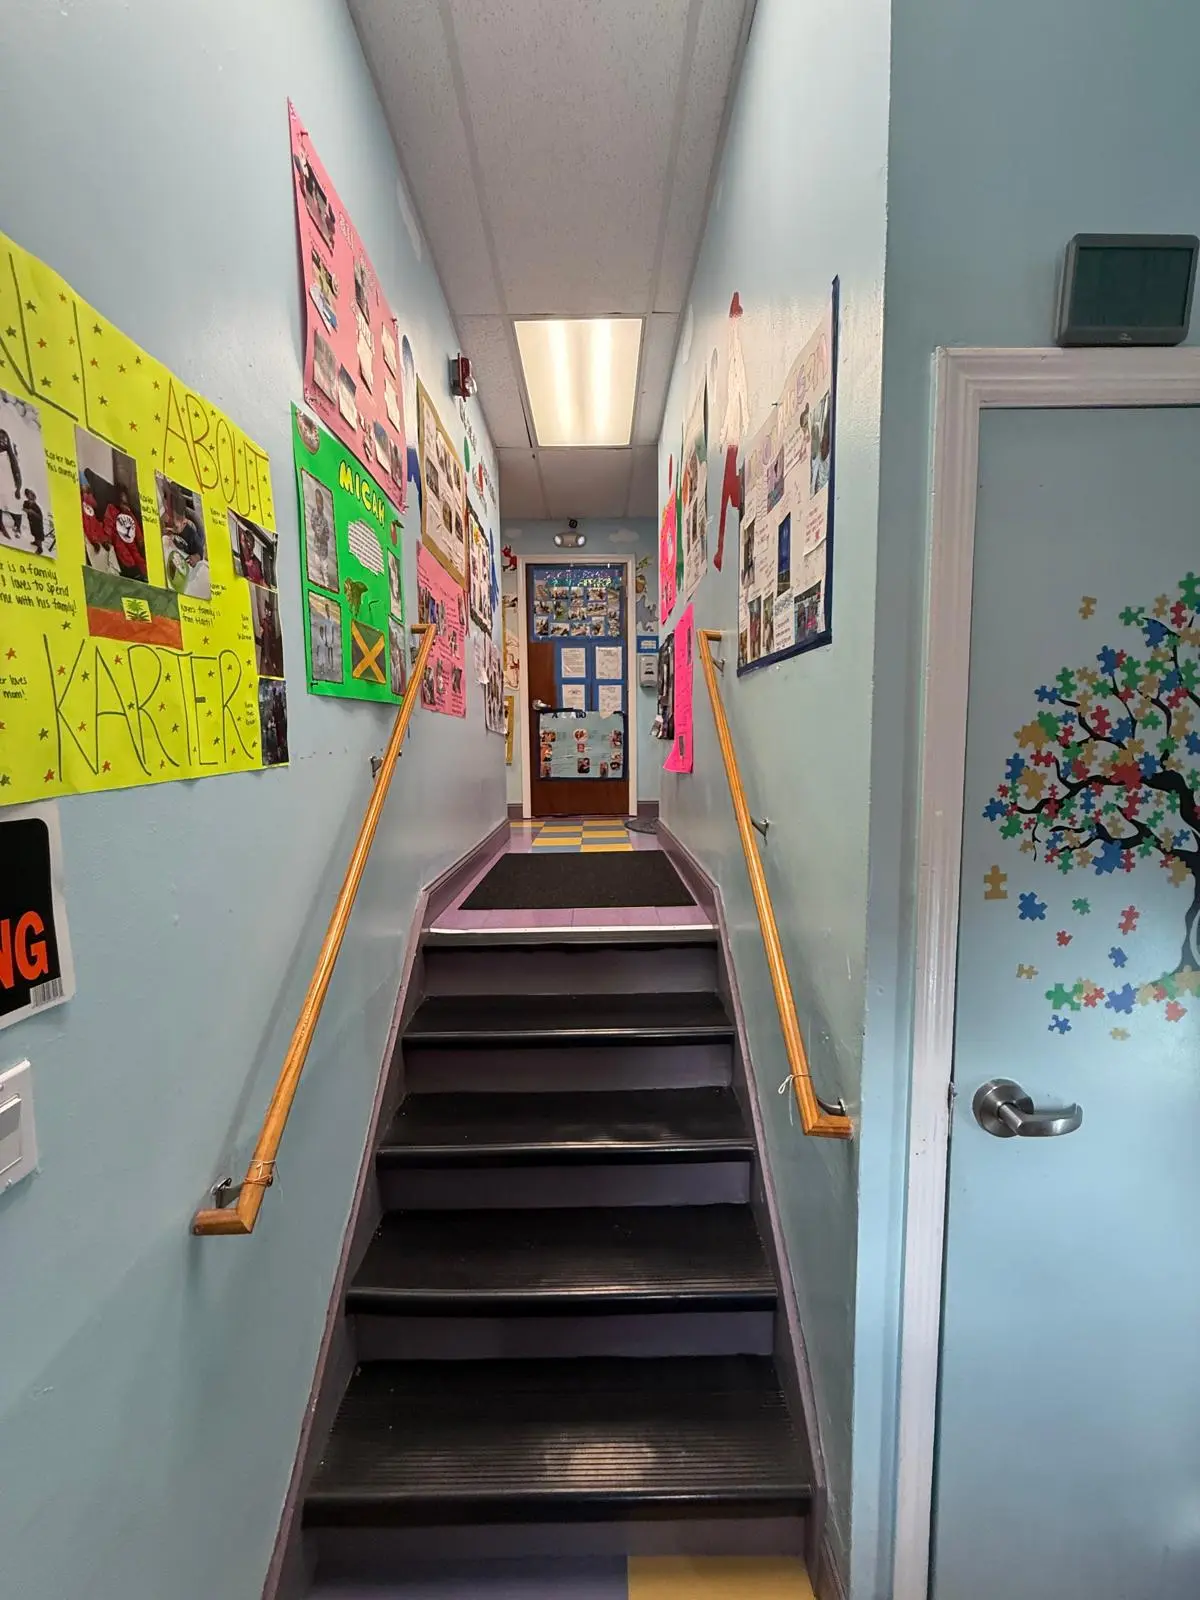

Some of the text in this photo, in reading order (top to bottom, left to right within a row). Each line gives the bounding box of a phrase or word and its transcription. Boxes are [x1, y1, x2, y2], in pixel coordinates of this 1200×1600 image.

[163, 377, 269, 525] ABOUT
[339, 459, 385, 528] MICAH
[7, 561, 16, 573] is
[20, 565, 27, 575] a
[27, 562, 58, 584] family
[32, 579, 44, 592] to
[43, 634, 254, 781] KARTER
